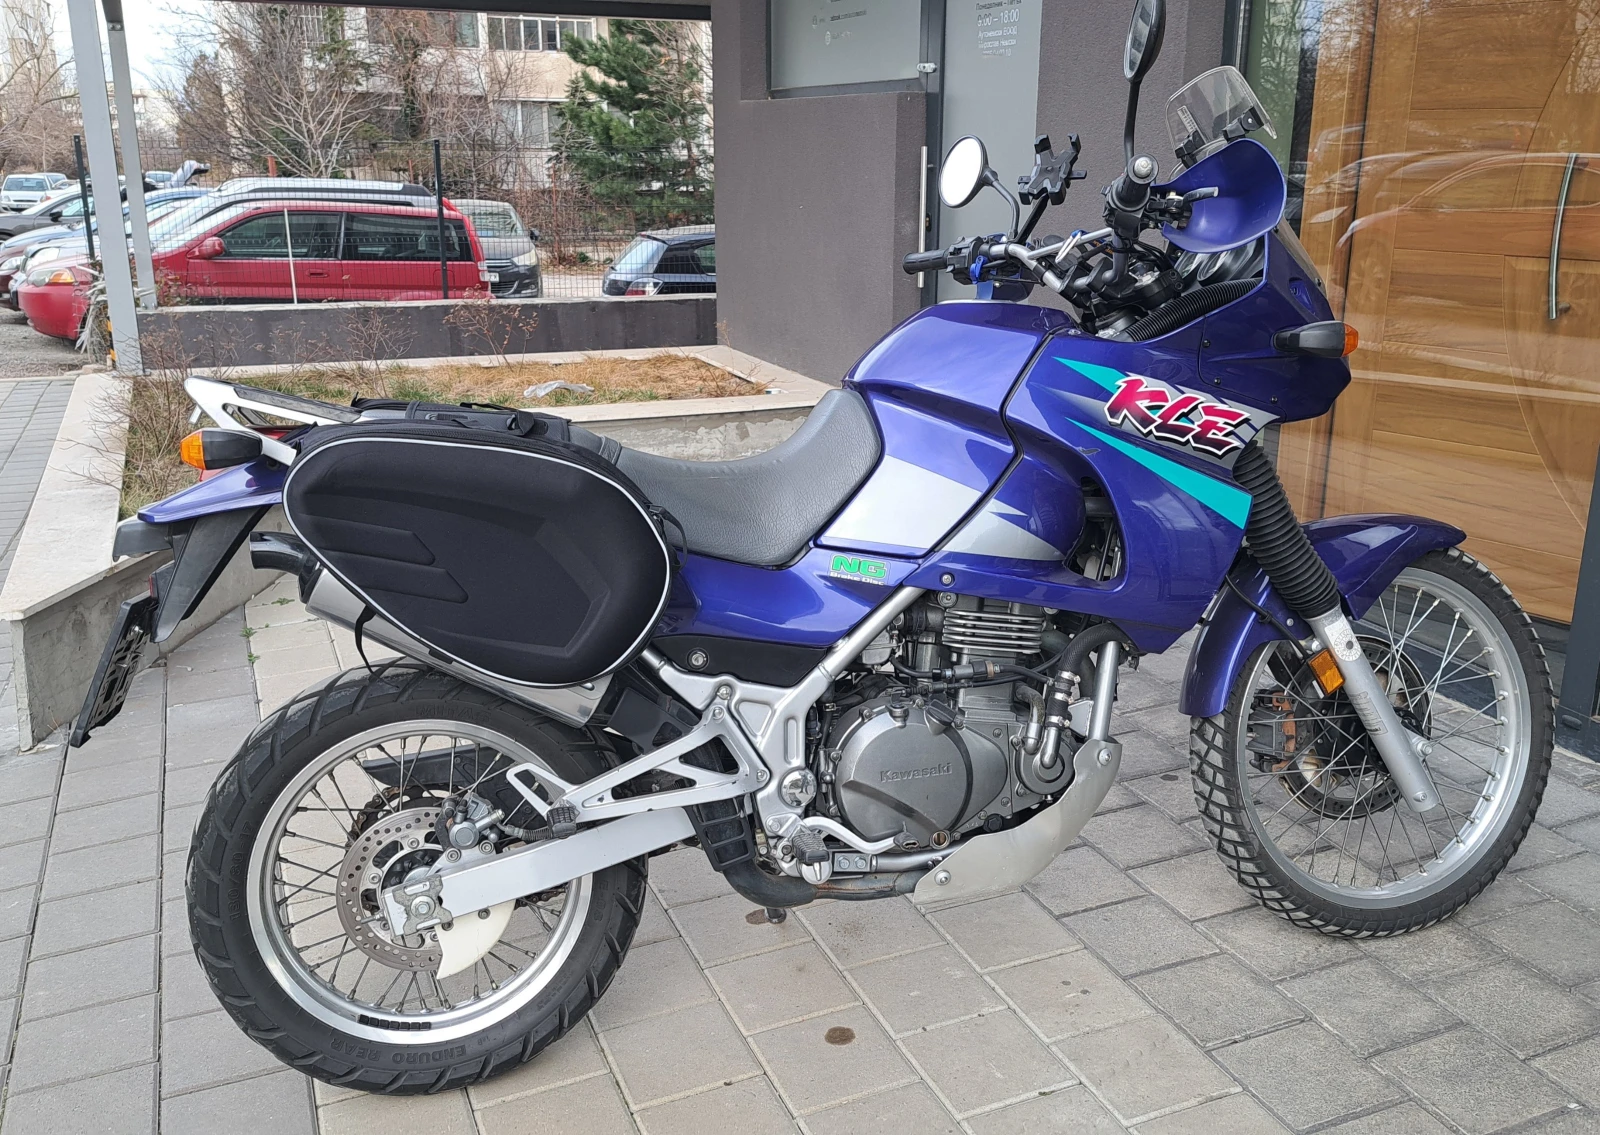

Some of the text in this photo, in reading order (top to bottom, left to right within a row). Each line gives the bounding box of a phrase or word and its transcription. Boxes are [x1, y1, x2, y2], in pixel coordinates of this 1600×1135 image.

[1000, 8, 1020, 24] 18:00
[1104, 376, 1251, 460] KLE
[831, 555, 887, 579] NG
[830, 571, 885, 587] Brake Disc
[880, 762, 953, 783] Kawasaki
[330, 1038, 467, 1064] ENDURO REAR
